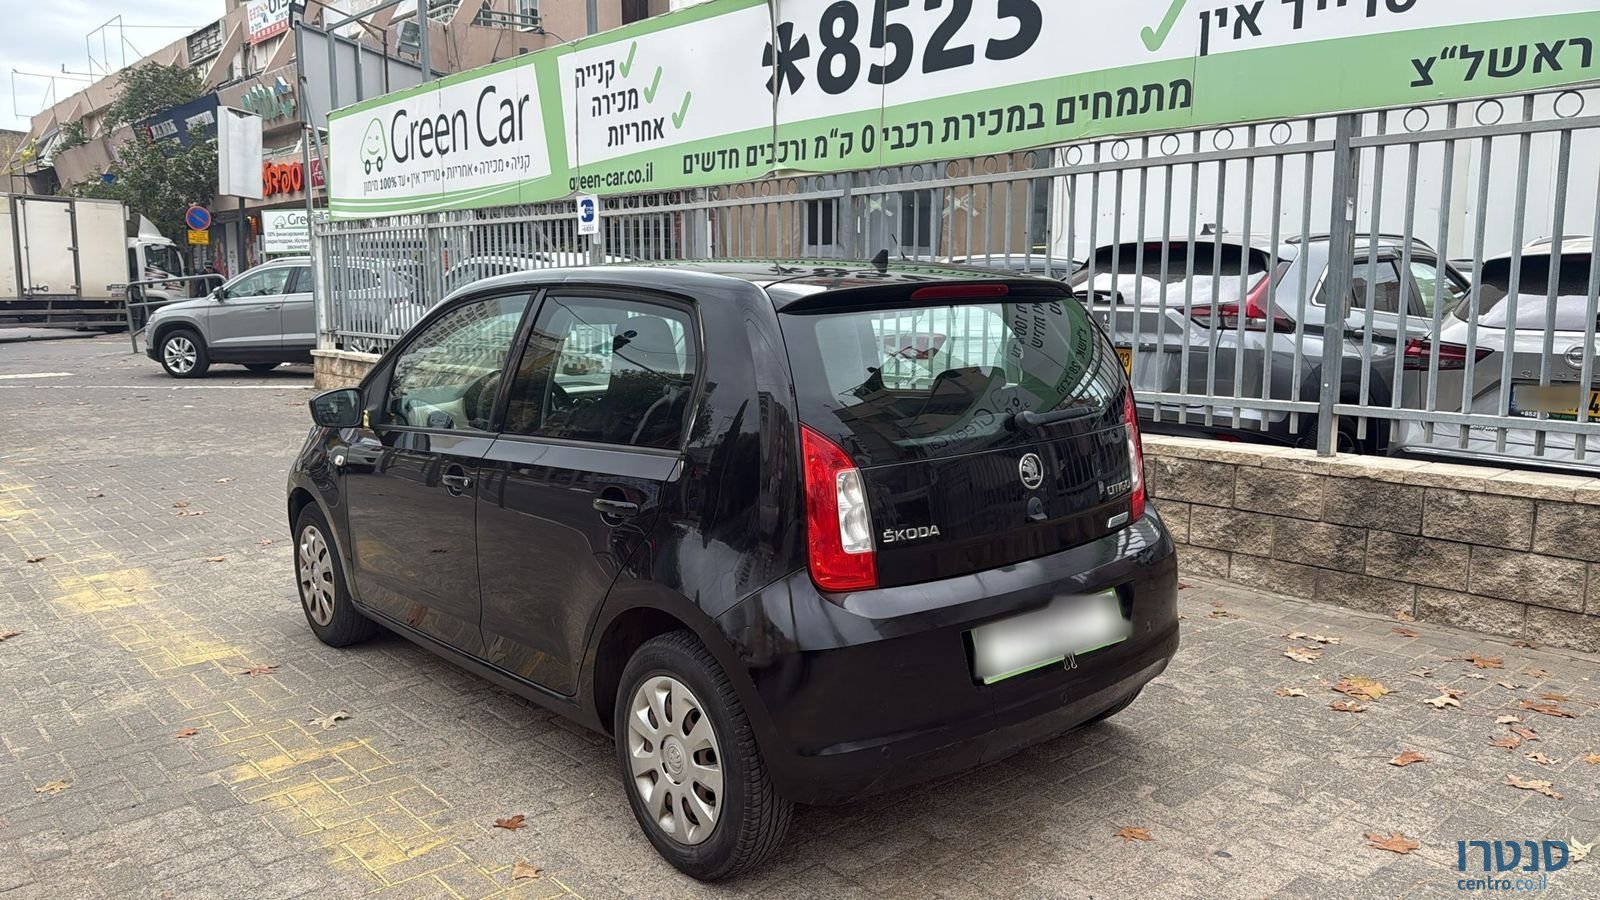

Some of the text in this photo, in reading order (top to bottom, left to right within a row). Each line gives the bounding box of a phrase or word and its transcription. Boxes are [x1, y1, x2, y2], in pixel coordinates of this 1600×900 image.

[1199, 0, 1265, 56] אין
[575, 59, 615, 89] קנייה
[591, 87, 639, 118] מכירה
[1055, 78, 1192, 126] מתמחים
[391, 85, 530, 164] Green Car
[607, 116, 665, 148] אחריות
[882, 121, 934, 151] רכבי
[940, 102, 1045, 144] במכירת
[511, 154, 531, 174] קניה
[682, 148, 740, 175] חדשים
[746, 137, 807, 167] ורכבים
[410, 171, 420, 189] אין
[422, 168, 440, 183] טרייד
[446, 163, 473, 180] אחריות
[479, 158, 504, 175] מכירה
[569, 162, 653, 191] geen-car.co.il
[380, 176, 398, 190] 100%
[287, 213, 309, 226] Gre
[1521, 411, 1549, 419] 852
[883, 524, 940, 543] ŠKODA
